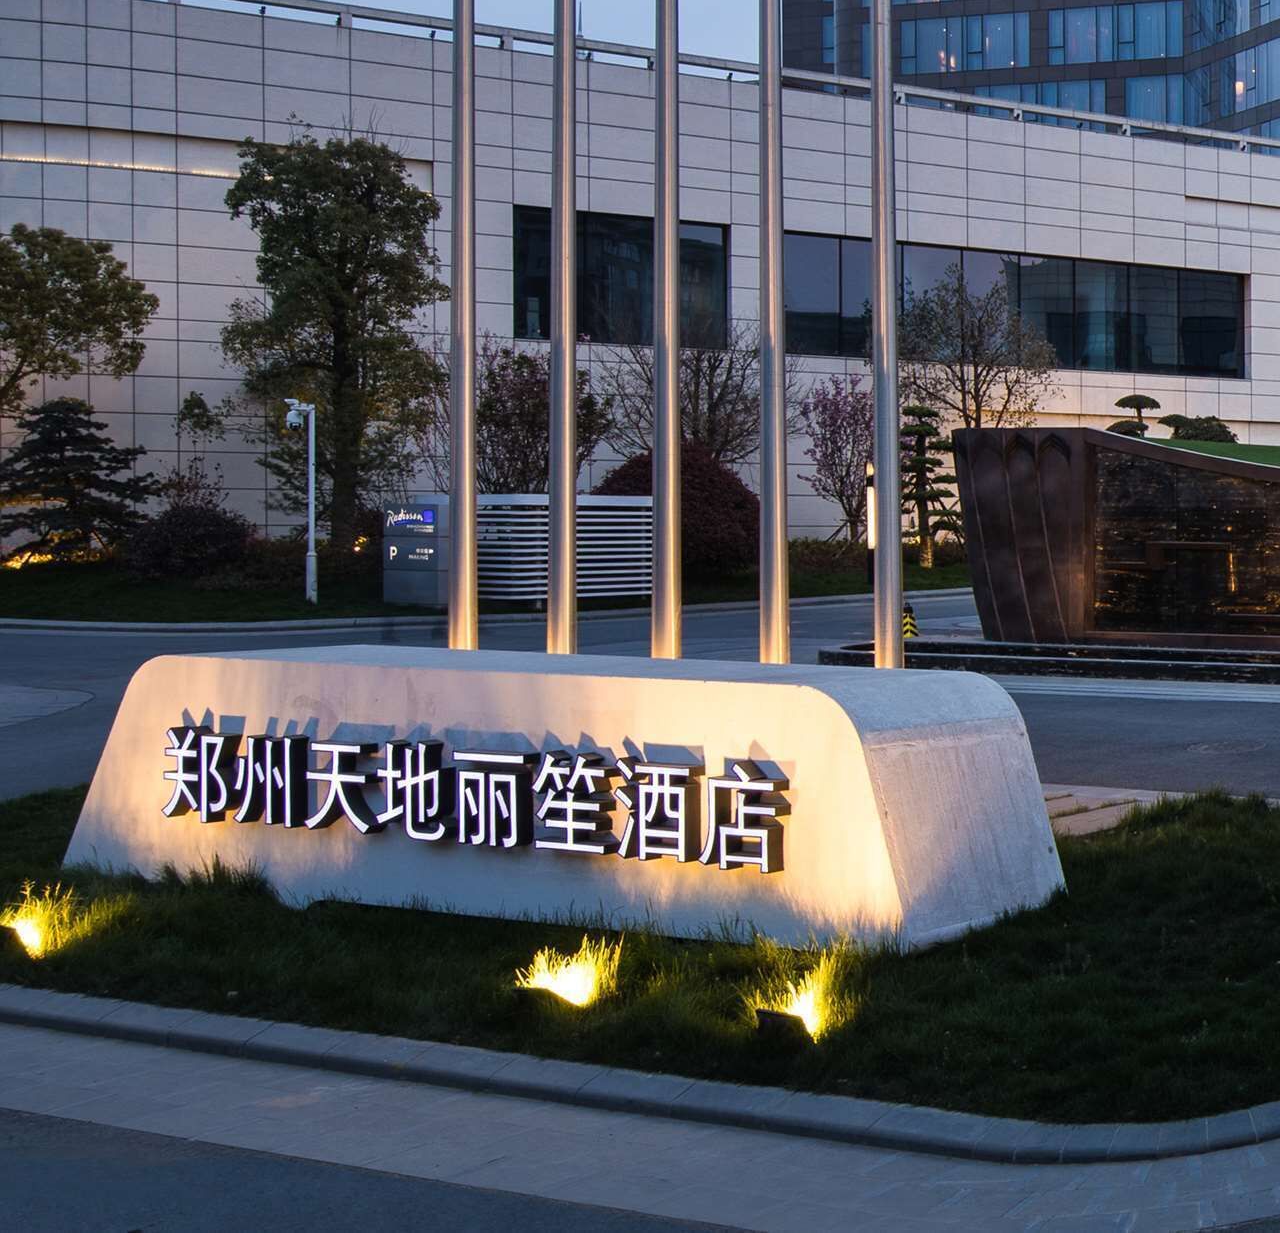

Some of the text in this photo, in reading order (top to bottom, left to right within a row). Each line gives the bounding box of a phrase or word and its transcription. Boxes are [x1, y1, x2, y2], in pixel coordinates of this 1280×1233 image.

[389, 546, 398, 560] P
[162, 726, 787, 874] 郑州天地丽笙酒店
